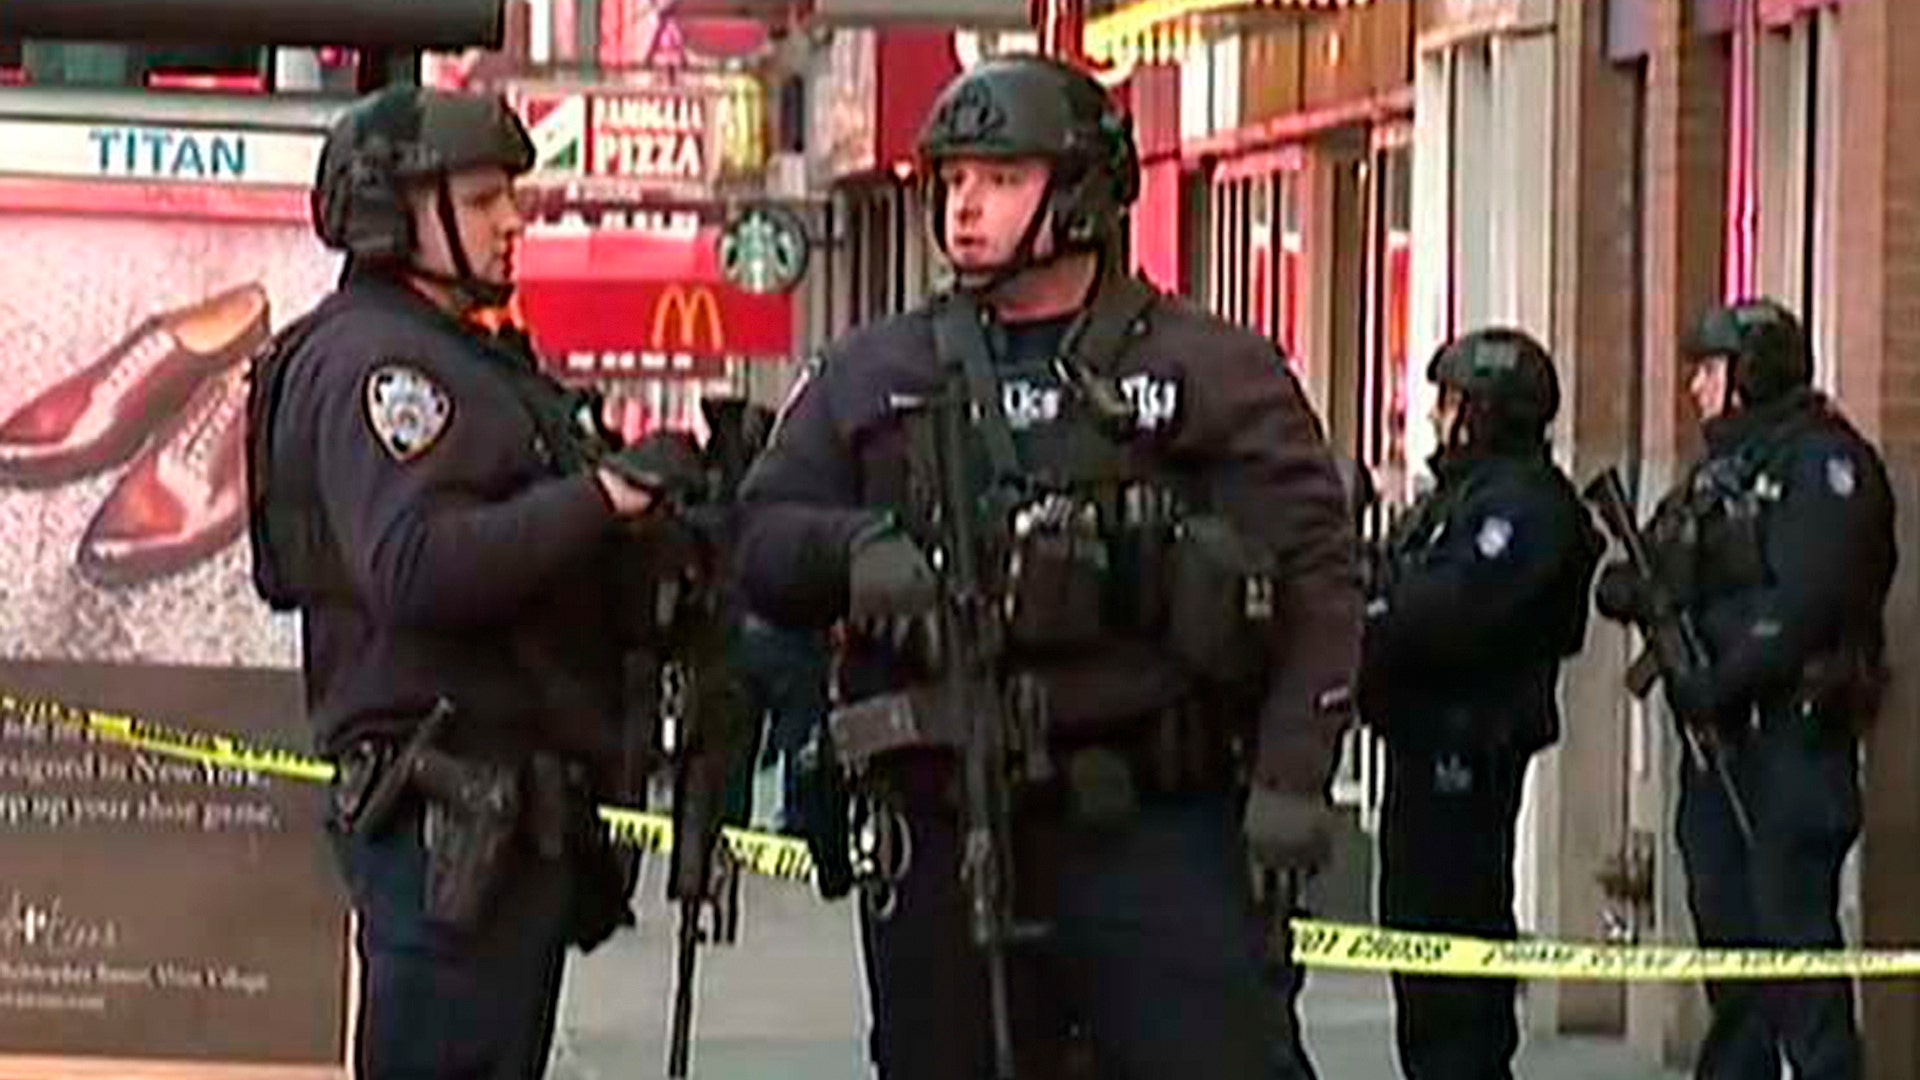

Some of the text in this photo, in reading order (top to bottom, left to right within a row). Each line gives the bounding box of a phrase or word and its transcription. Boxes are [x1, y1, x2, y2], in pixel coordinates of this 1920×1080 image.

[88, 129, 244, 176] TITAN
[595, 131, 703, 176] PIZZA
[1347, 932, 1451, 963] CROSS
